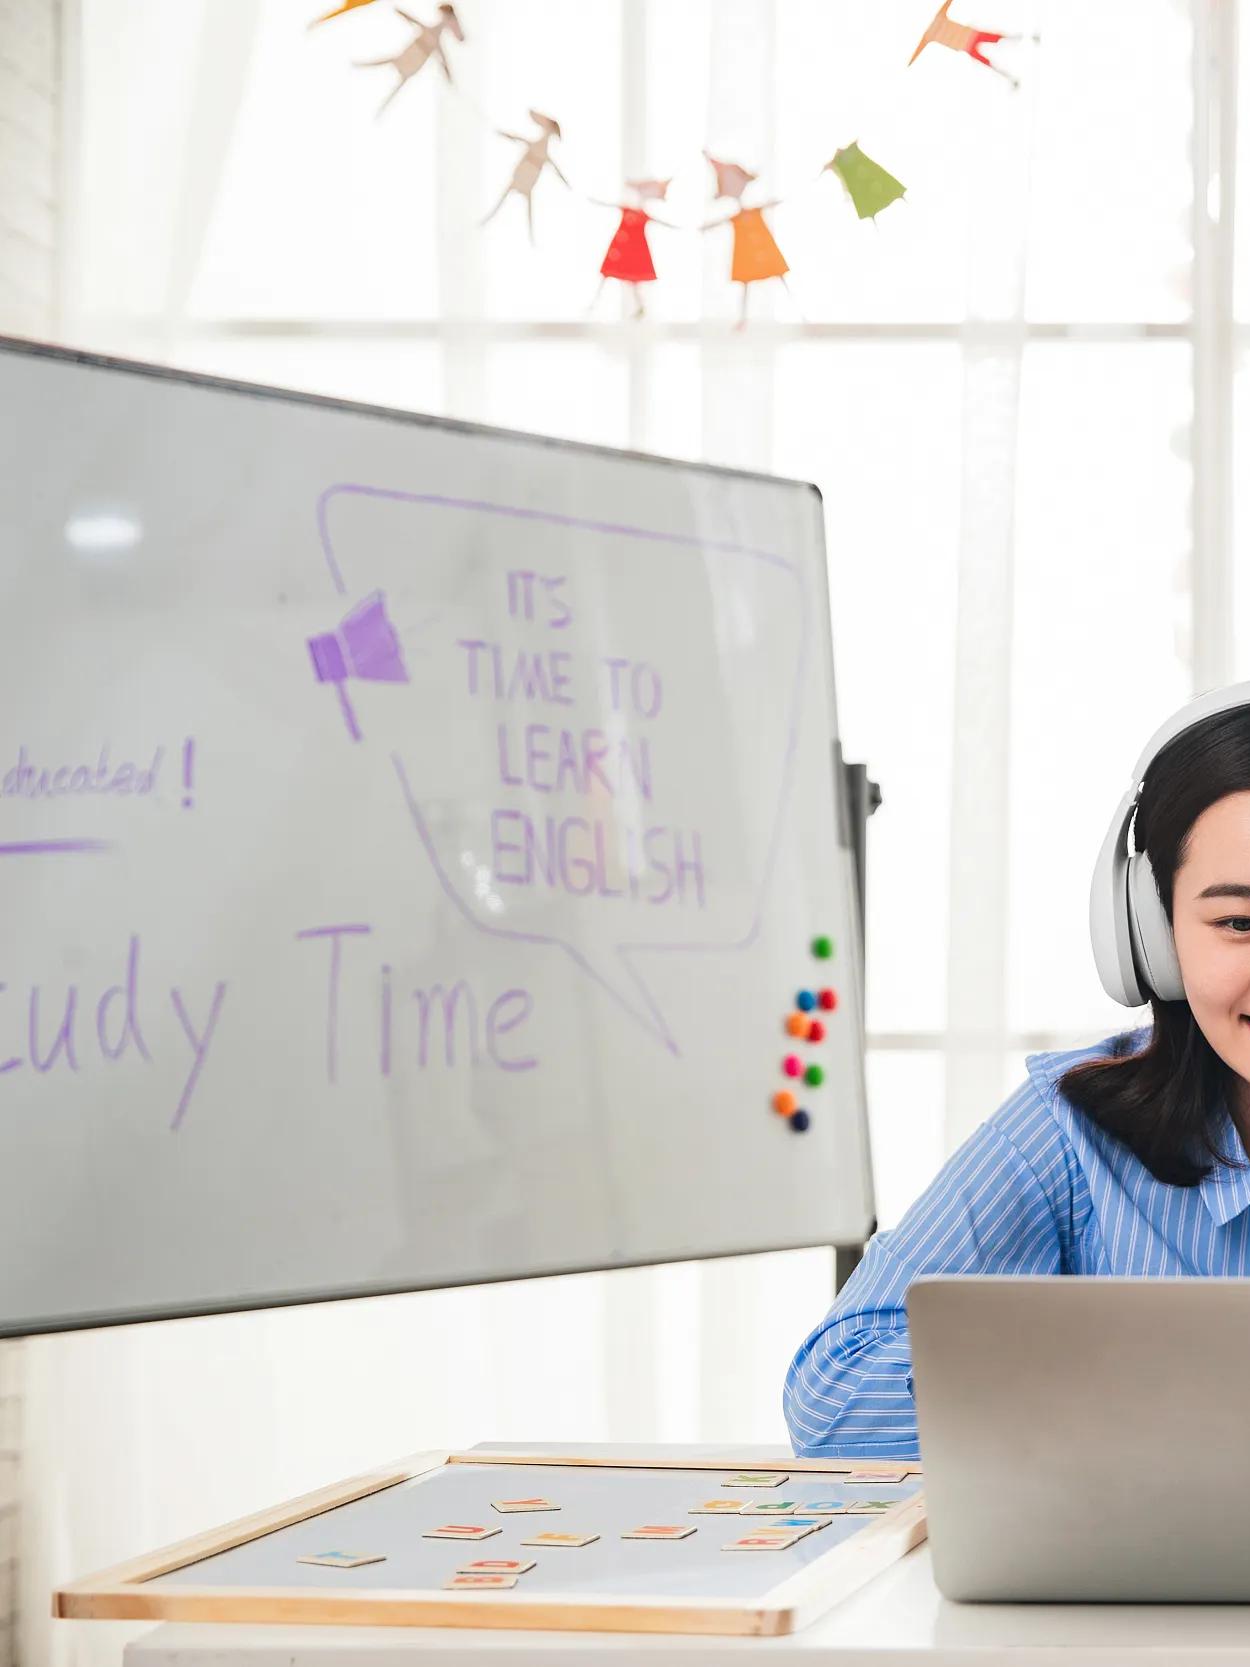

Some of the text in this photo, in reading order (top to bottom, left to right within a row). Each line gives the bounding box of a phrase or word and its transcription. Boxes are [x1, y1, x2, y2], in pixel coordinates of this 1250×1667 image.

[456, 639, 664, 719] TIME TO
[0, 735, 197, 810] ducated!
[497, 722, 653, 804] LEARN
[491, 808, 706, 911] ENGLISH
[295, 923, 540, 1085] Time
